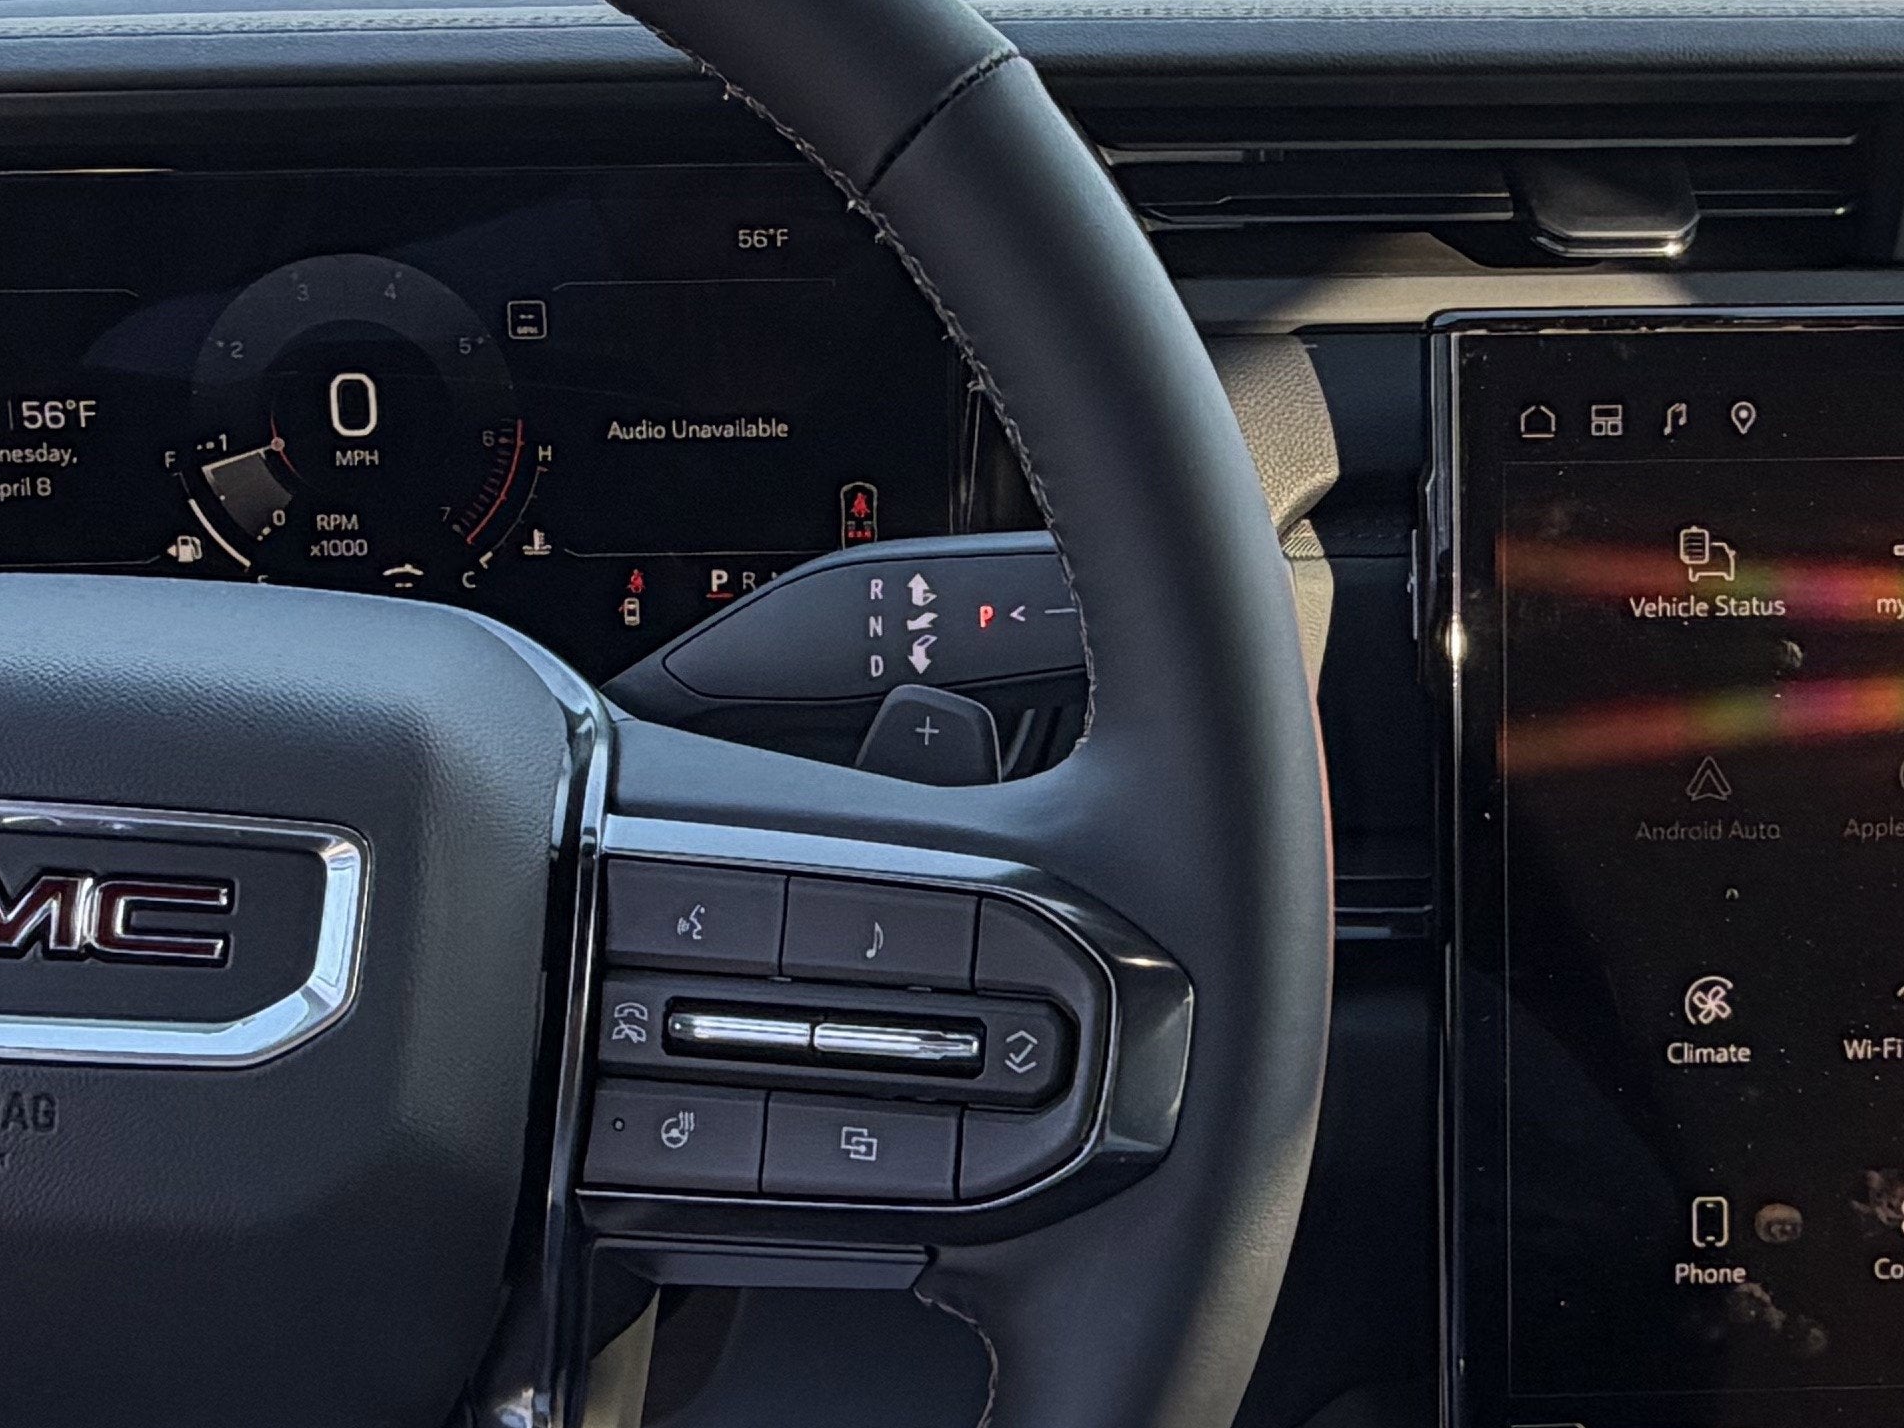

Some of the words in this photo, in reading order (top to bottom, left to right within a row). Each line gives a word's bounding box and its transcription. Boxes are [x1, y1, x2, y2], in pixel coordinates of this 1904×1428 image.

[229, 340, 244, 359] 2
[20, 399, 97, 431] 56°F
[329, 372, 379, 437] 0
[606, 419, 666, 440] Audio
[672, 417, 790, 440] Unavailable
[217, 434, 227, 451] 1
[165, 450, 177, 468] F
[335, 450, 379, 468] MPH
[537, 445, 552, 463] H
[36, 477, 53, 497] 8
[272, 510, 285, 527] 0
[315, 514, 359, 532] RPM
[309, 539, 369, 559] x1000
[461, 572, 476, 590] C
[710, 569, 729, 592] P
[869, 579, 884, 601] R
[979, 606, 994, 628] P
[1629, 596, 1709, 618] Vehicle
[1715, 595, 1786, 618] Status
[868, 616, 883, 638] N
[870, 655, 885, 678] D
[1635, 820, 1723, 842] Android
[1727, 821, 1782, 840] Auto
[1666, 1042, 1752, 1064] Climate
[1843, 1038, 1903, 1060] Wi-Fi
[1675, 1262, 1747, 1285] Phone
